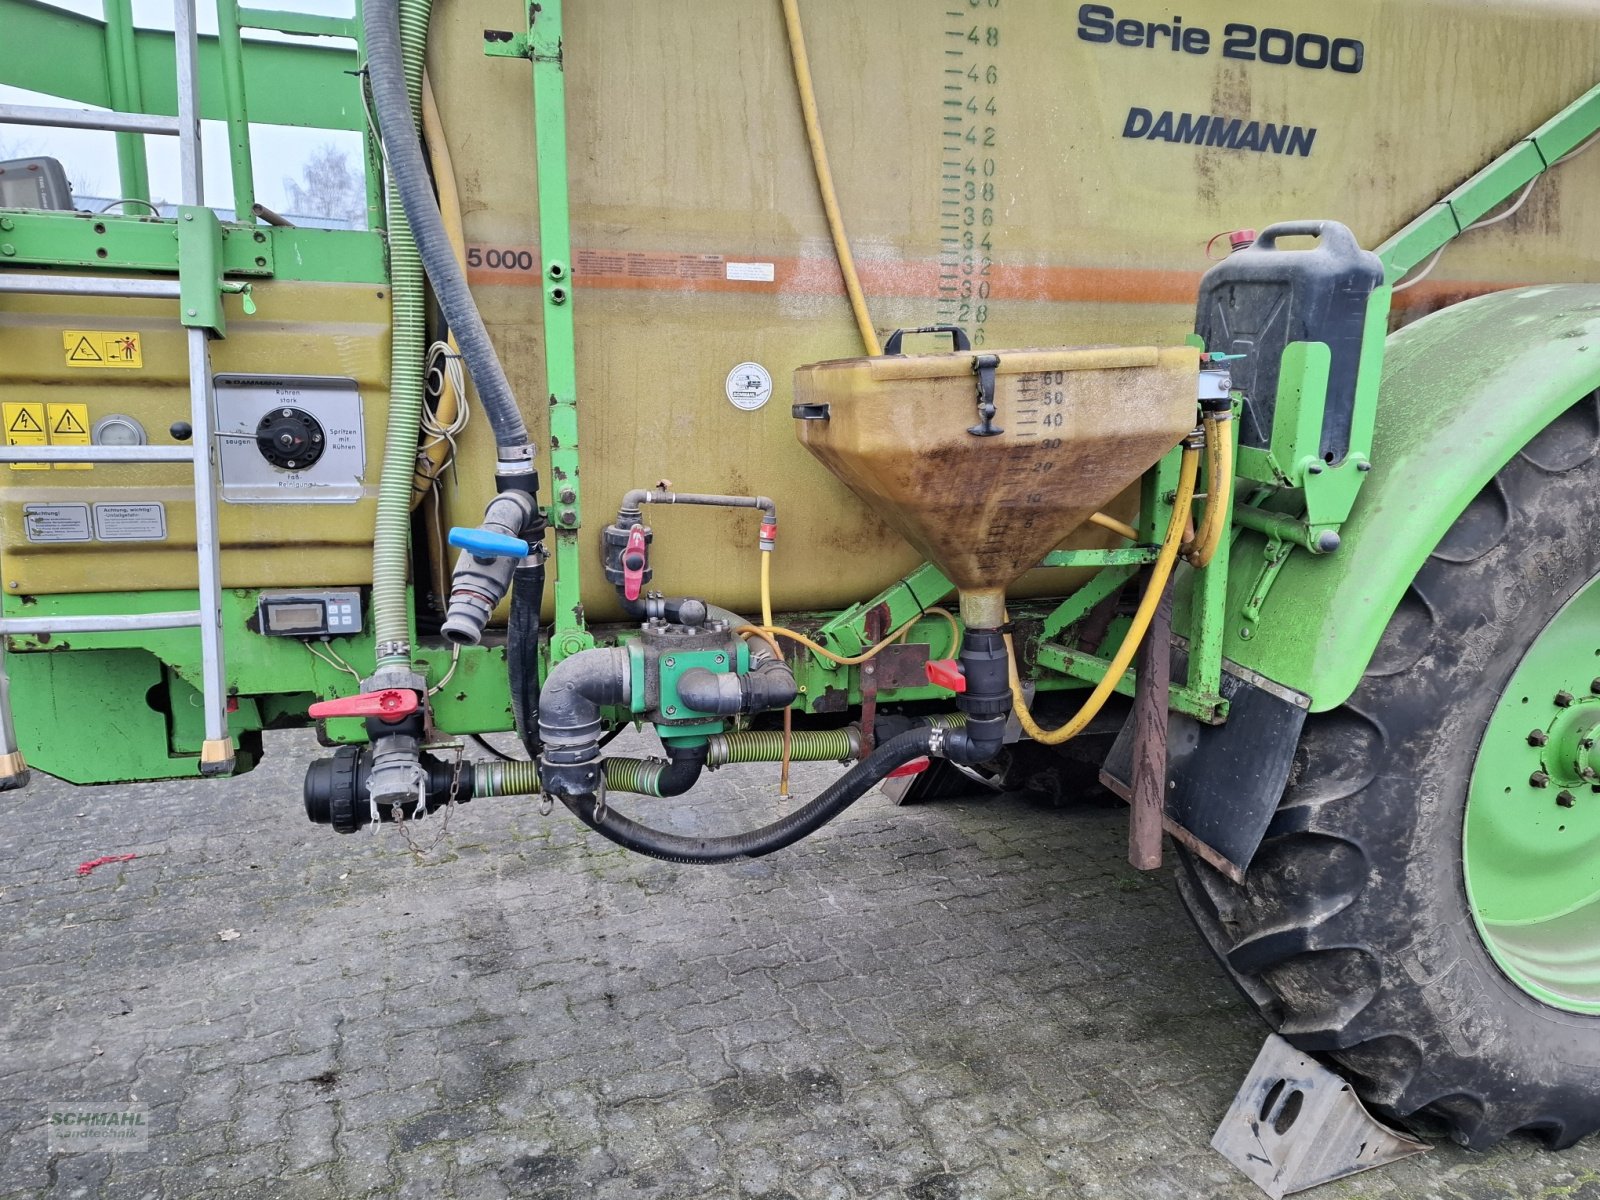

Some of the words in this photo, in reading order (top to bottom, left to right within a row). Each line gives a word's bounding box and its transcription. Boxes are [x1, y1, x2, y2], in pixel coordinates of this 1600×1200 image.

[967, 25, 999, 47] 48
[1077, 3, 1210, 55] Serie
[1223, 23, 1365, 74] 2000
[967, 63, 997, 84] 46
[966, 96, 997, 116] 44
[965, 126, 995, 146] 42
[1122, 107, 1317, 157] DAMMANN
[965, 157, 995, 177] 40
[964, 181, 994, 202] 38
[963, 206, 993, 227] 36
[963, 231, 992, 251] 34
[962, 255, 991, 276] 32
[961, 280, 990, 299] 30
[958, 304, 988, 323] 28
[1043, 371, 1064, 386] 60
[1044, 391, 1063, 405] 50
[1043, 413, 1063, 427] 40
[226, 438, 251, 446] saugen
[330, 428, 357, 436] Spritzen
[1041, 438, 1062, 450] 30
[1032, 462, 1053, 473] 20
